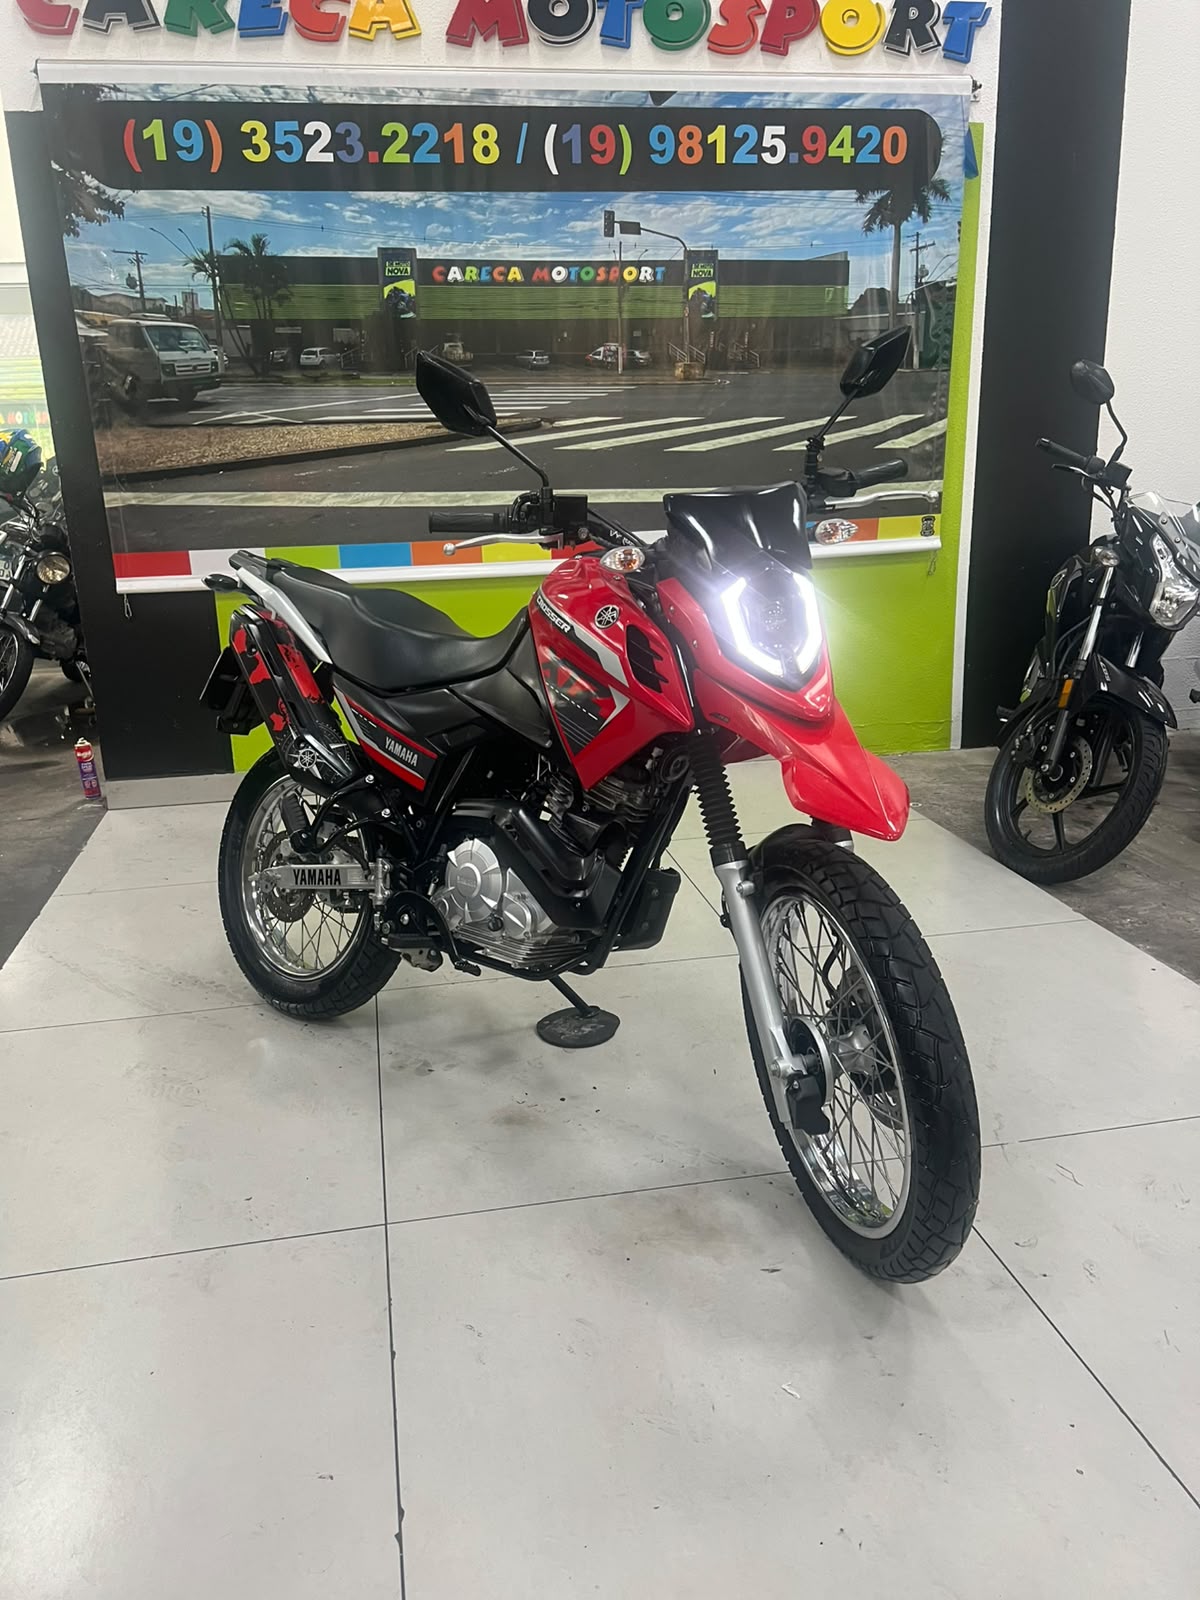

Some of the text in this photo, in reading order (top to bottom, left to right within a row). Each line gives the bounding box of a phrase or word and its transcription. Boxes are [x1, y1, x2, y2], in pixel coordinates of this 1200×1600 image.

[445, 0, 992, 64] MOTOSPORT
[123, 118, 907, 175] (19) 3523.2218 / (19) 98125.9420
[432, 265, 666, 283] CARECA MOTOSPORT
[385, 736, 418, 767] YAMAHA
[293, 869, 341, 885] YAMAHA
